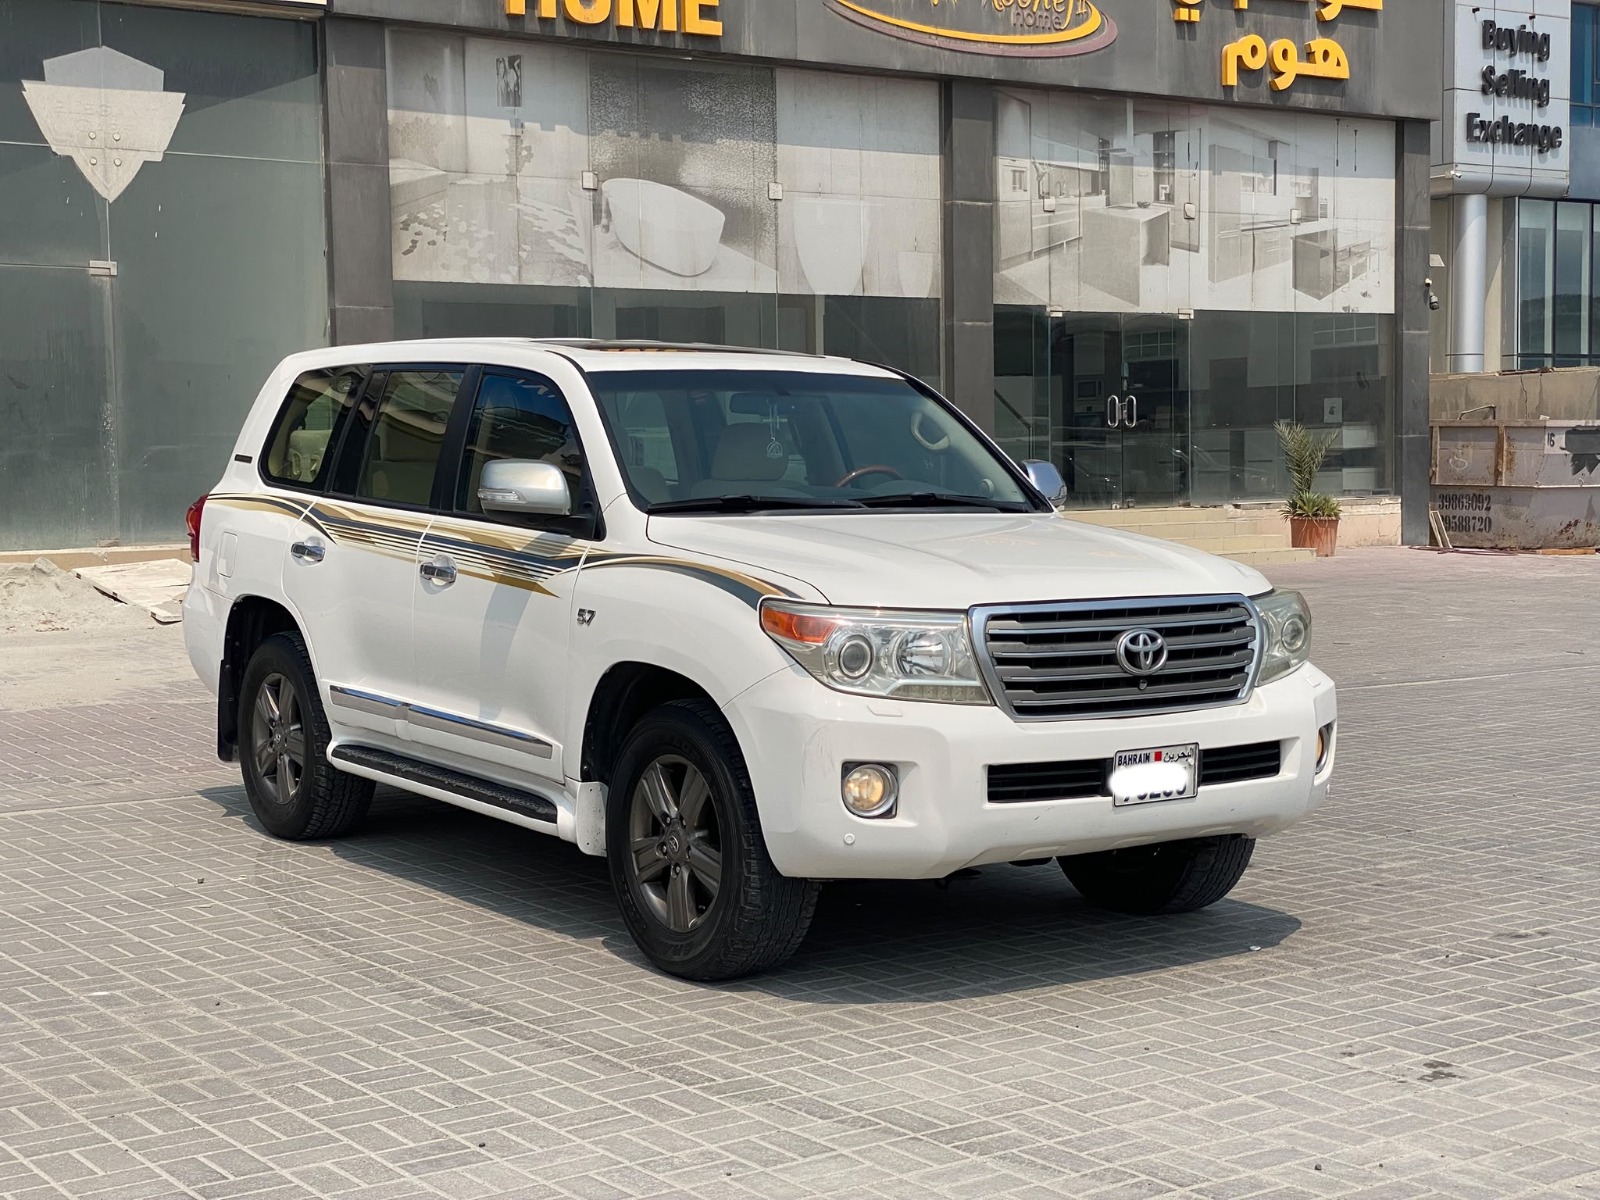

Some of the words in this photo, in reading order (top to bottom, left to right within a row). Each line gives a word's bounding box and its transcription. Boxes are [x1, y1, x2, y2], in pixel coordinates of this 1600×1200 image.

[505, 0, 723, 37] ME
[1482, 20, 1550, 62] Buying
[1221, 34, 1350, 91] هوم
[1481, 65, 1550, 108] Selling
[1466, 112, 1562, 153] Exchange
[1117, 752, 1150, 766] BAHRAIN
